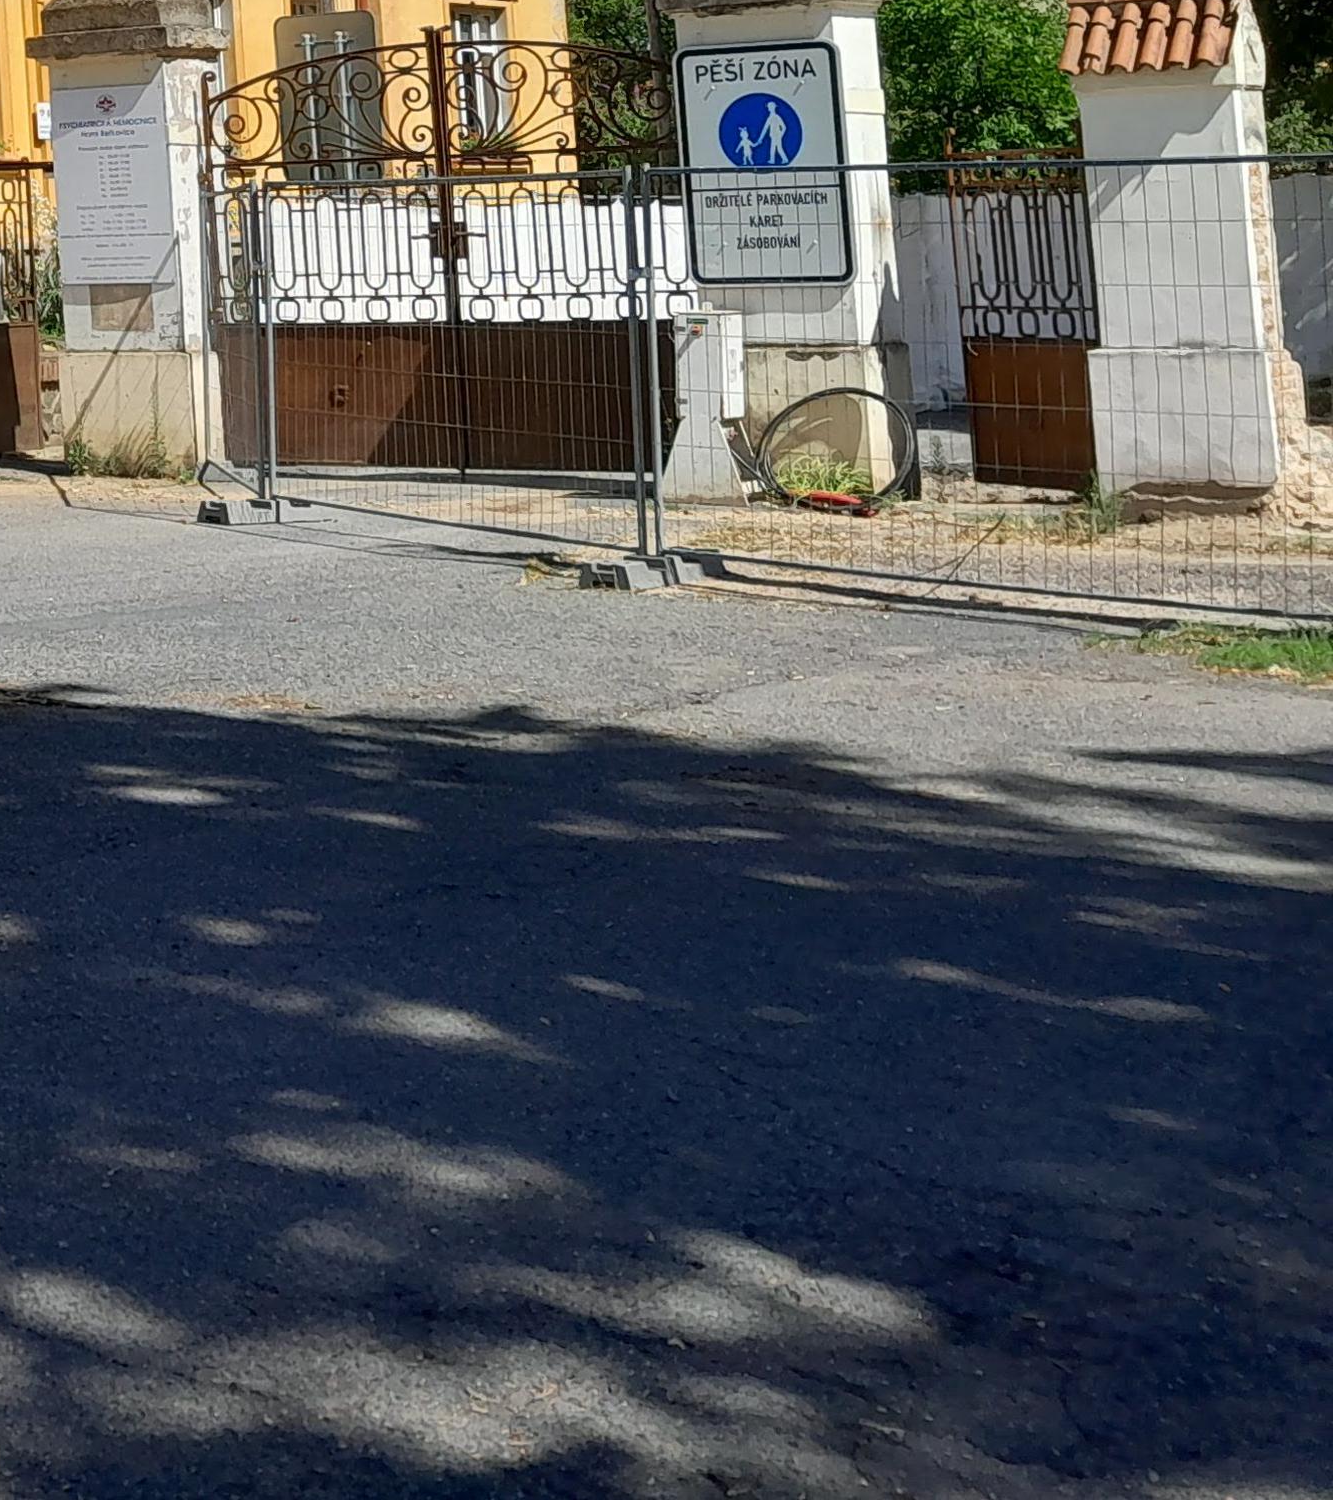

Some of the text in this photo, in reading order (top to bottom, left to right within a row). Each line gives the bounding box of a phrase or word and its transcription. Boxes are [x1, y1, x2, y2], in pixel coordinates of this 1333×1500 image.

[695, 55, 816, 84] PĚŠÍ ZÓNA
[705, 191, 828, 208] DRŽITELÉ PARKOVACÍCH
[749, 214, 783, 228] KARET
[737, 234, 800, 250] ZÁSOBOVÁNÍ
